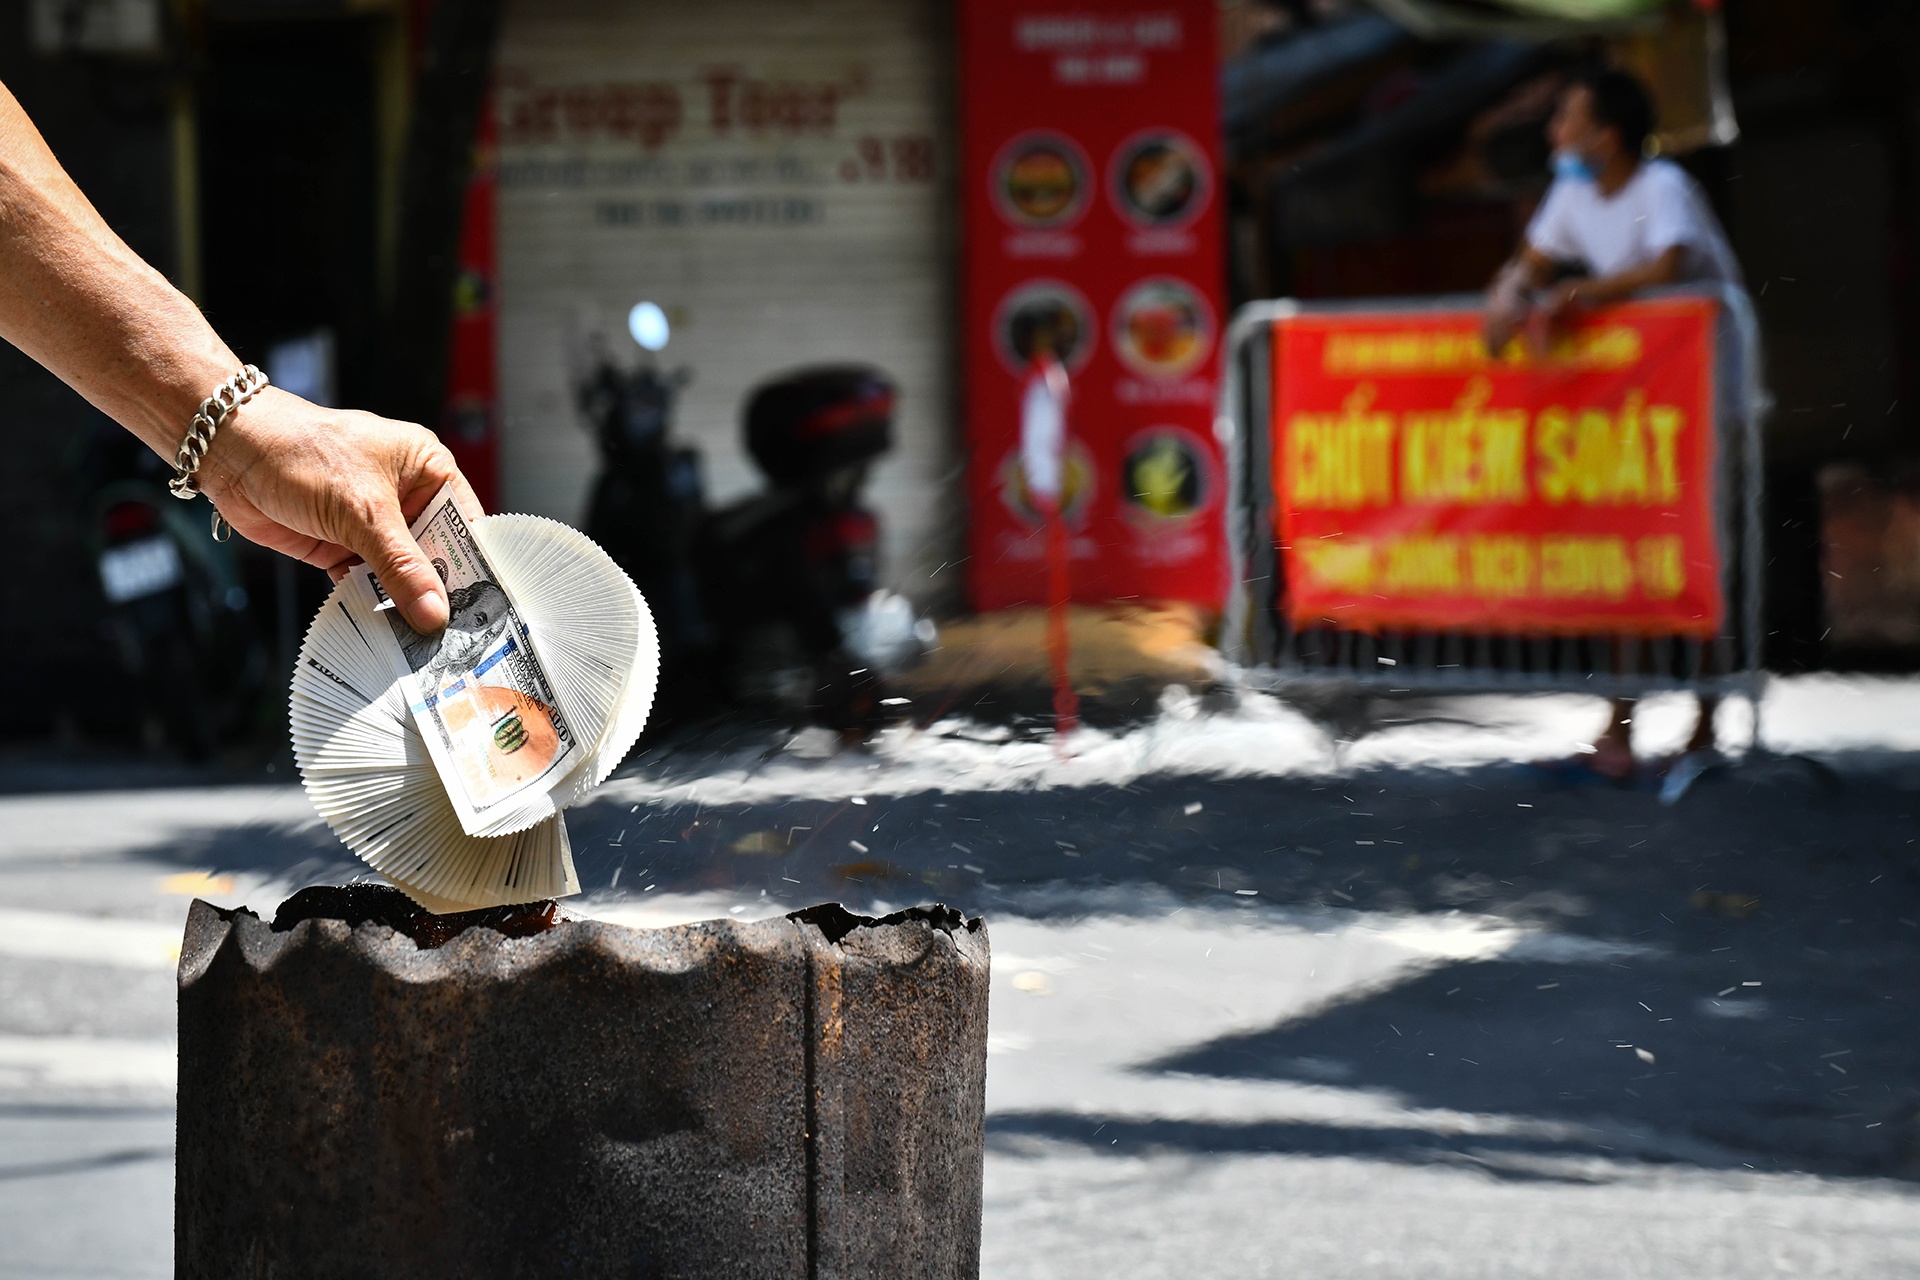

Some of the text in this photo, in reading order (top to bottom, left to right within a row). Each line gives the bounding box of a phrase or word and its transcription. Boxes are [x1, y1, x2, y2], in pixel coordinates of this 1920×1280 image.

[1534, 389, 1684, 503] SOÁT
[445, 504, 467, 538] 100
[548, 706, 568, 742] 100
